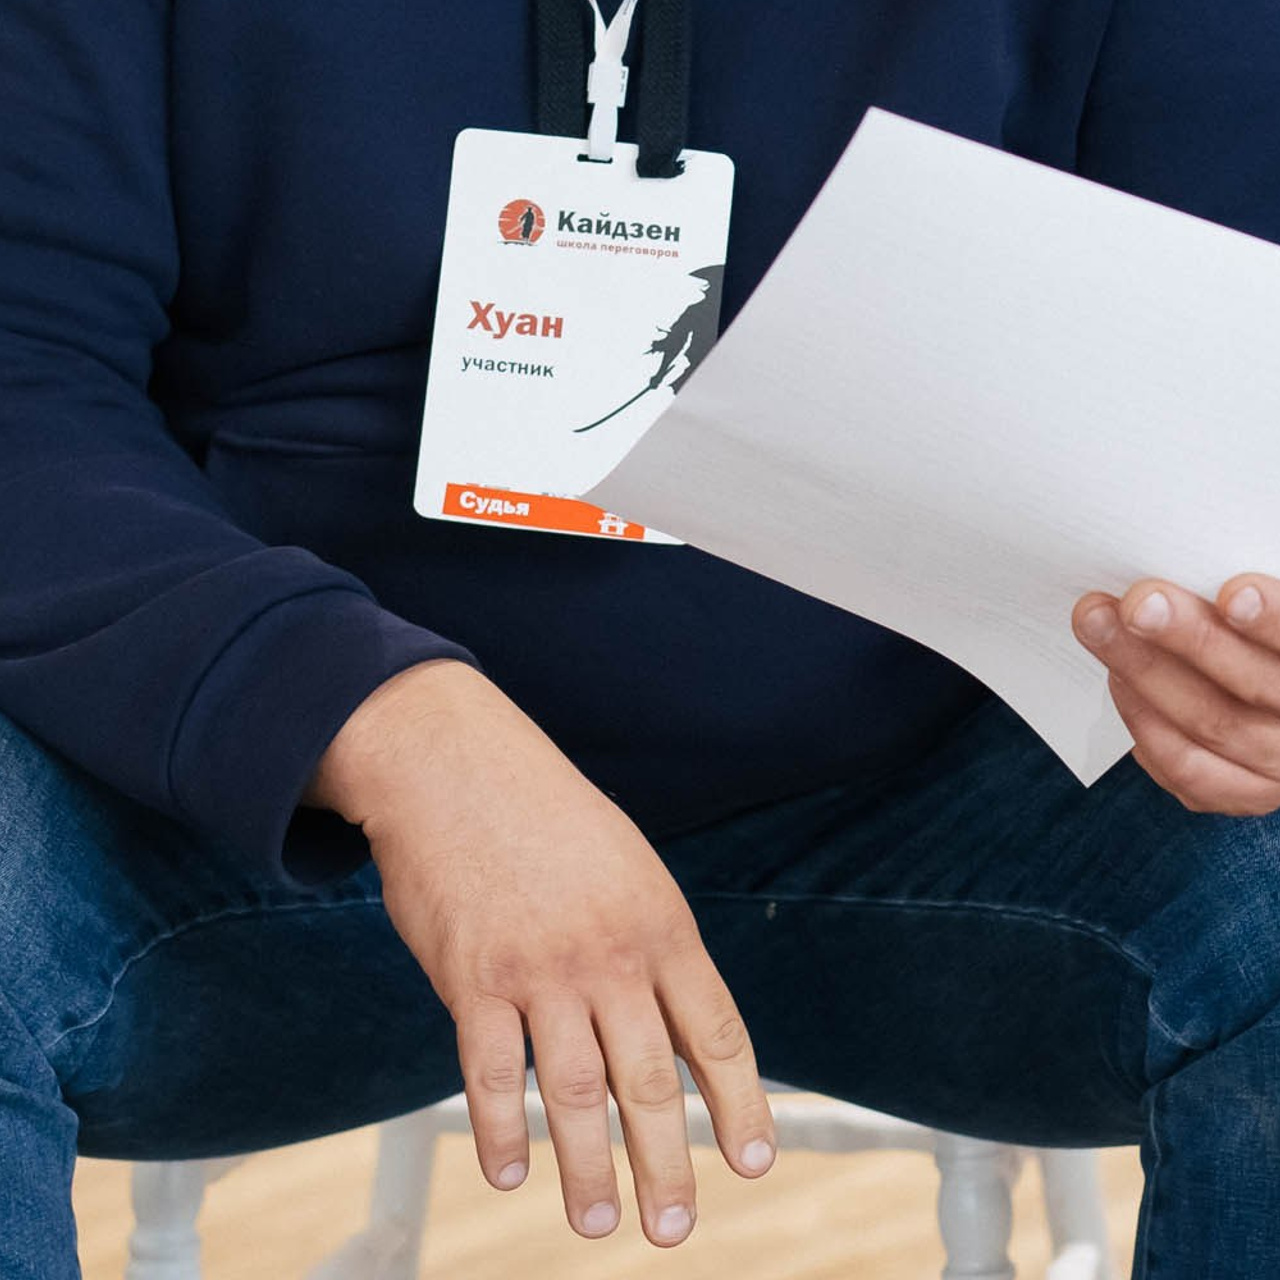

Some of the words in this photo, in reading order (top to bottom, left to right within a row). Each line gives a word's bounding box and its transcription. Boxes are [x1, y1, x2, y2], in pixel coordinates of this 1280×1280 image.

[558, 209, 680, 242] Кайдзен
[556, 239, 598, 251] школа
[600, 243, 679, 259] переговоров
[467, 300, 563, 339] Хуан
[461, 356, 554, 378] участник
[459, 490, 530, 517] Судья
